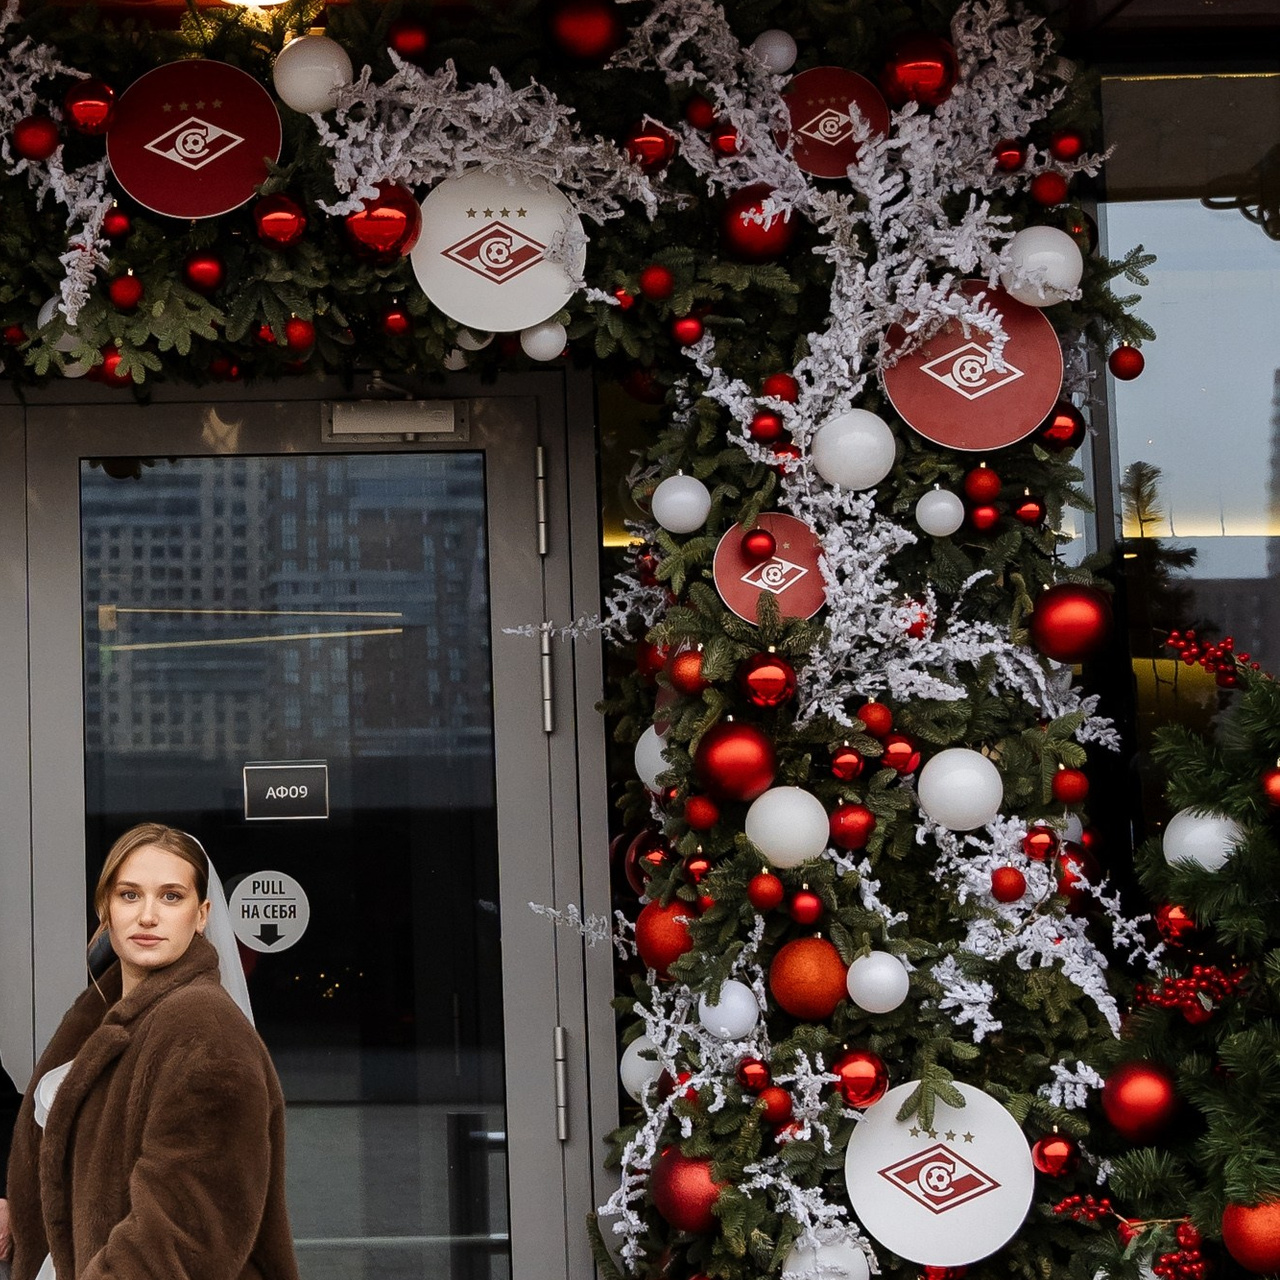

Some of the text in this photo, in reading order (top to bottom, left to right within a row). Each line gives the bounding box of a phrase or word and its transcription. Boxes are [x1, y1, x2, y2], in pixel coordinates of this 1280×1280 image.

[265, 785, 308, 800] АФ09
[252, 880, 286, 895] PULL
[241, 904, 297, 919] НА СЕБЯ
